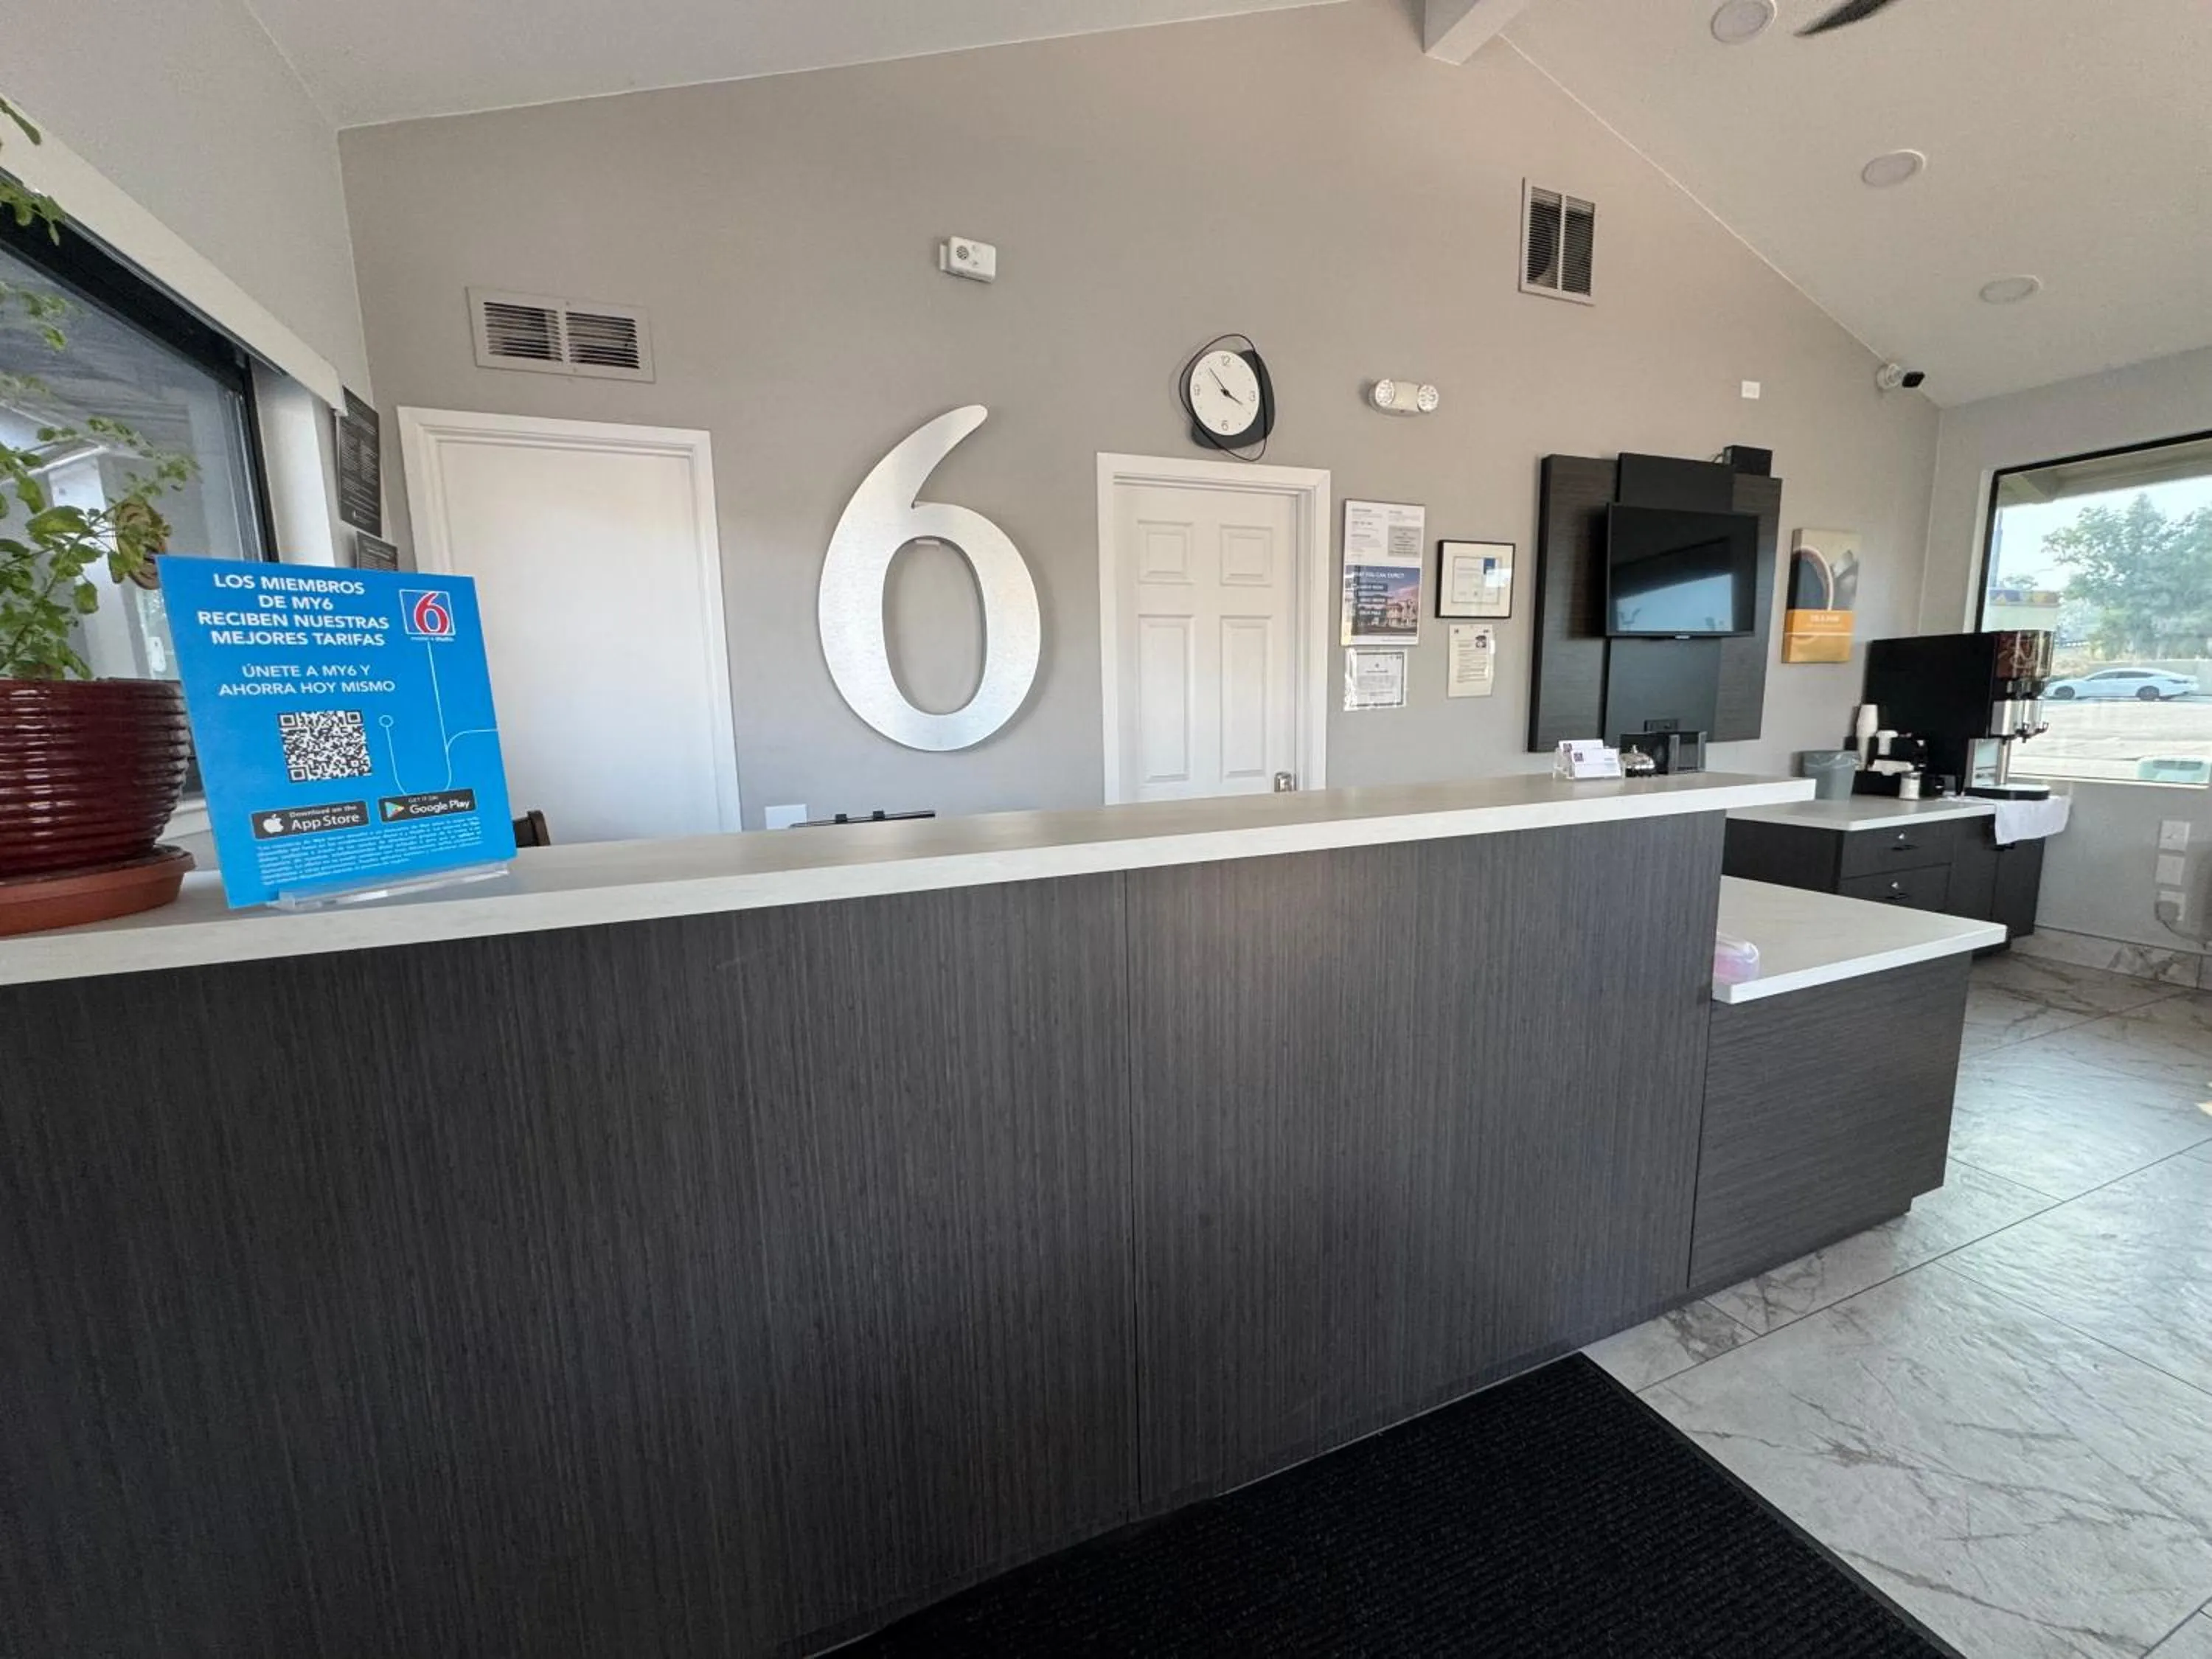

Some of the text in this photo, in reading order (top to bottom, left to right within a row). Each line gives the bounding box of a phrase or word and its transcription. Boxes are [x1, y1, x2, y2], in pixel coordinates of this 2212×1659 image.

[1221, 355, 1231, 366] 12
[1221, 420, 1229, 431] 6
[213, 573, 365, 595] LOS MIEMBROS
[818, 404, 1041, 751] 6
[258, 594, 334, 611] DE MY6
[197, 611, 389, 630] RECIBEN NUESTRAS
[414, 591, 449, 634] 6
[210, 630, 386, 647] MEJORES TARIFAS
[242, 663, 371, 678] ÚNETE A MY6 Y
[218, 680, 396, 696] AHORRA HOY MISMO
[288, 807, 330, 818] Download
[409, 799, 470, 814] Google Play
[291, 814, 360, 832] App Store
